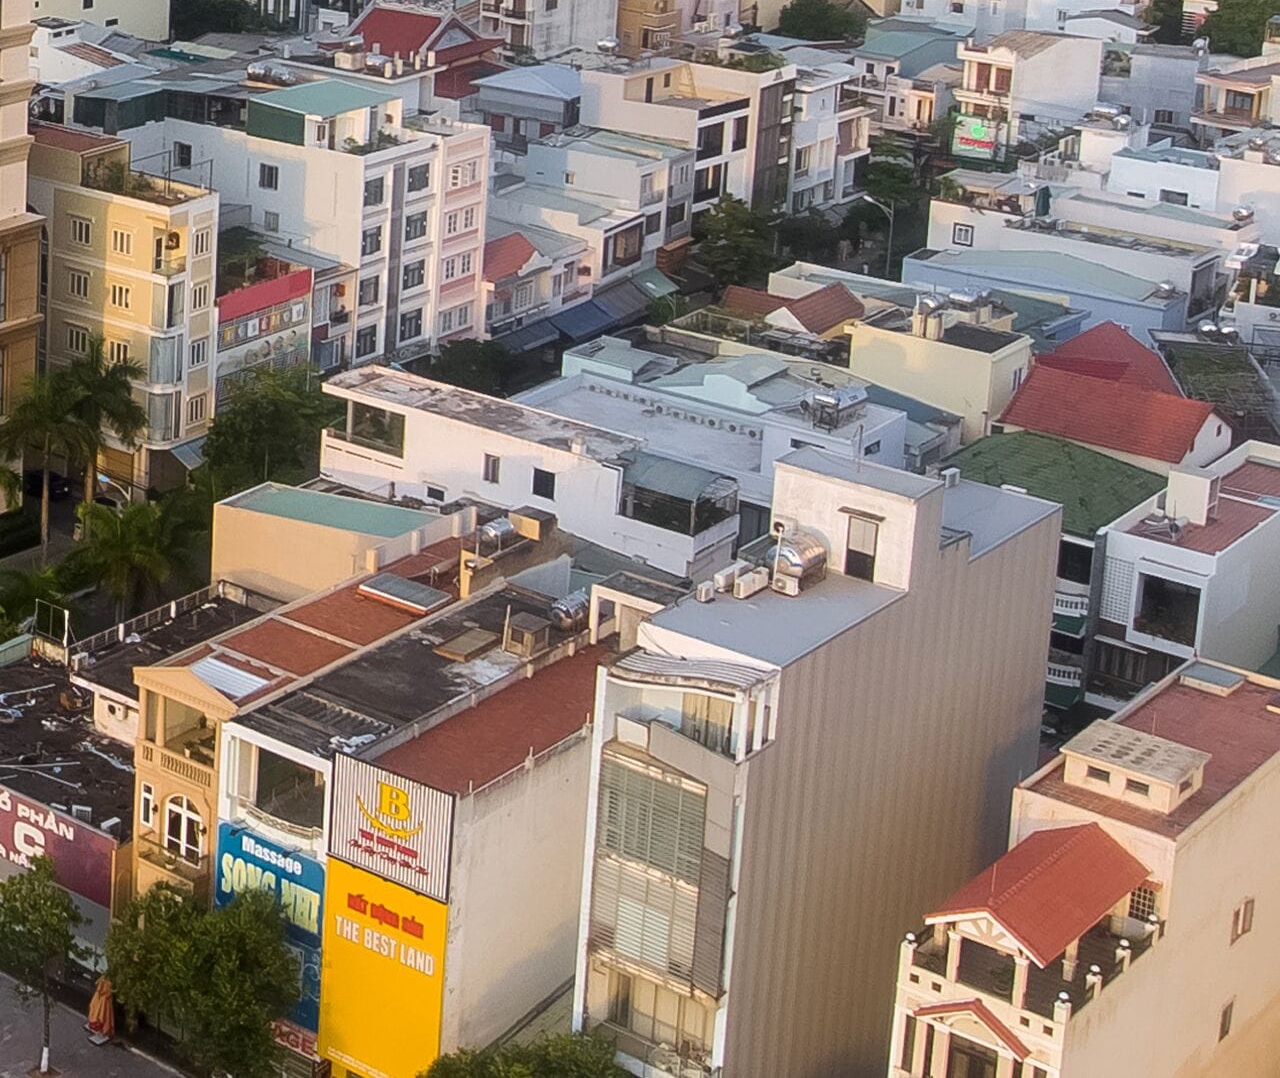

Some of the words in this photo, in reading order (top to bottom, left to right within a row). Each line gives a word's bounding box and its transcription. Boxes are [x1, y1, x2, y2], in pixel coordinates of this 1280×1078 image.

[17, 802, 75, 841] PHẦN
[241, 835, 303, 876] Massage
[335, 914, 360, 944] THE
[364, 927, 398, 960] BEST
[400, 943, 435, 977] LAND
